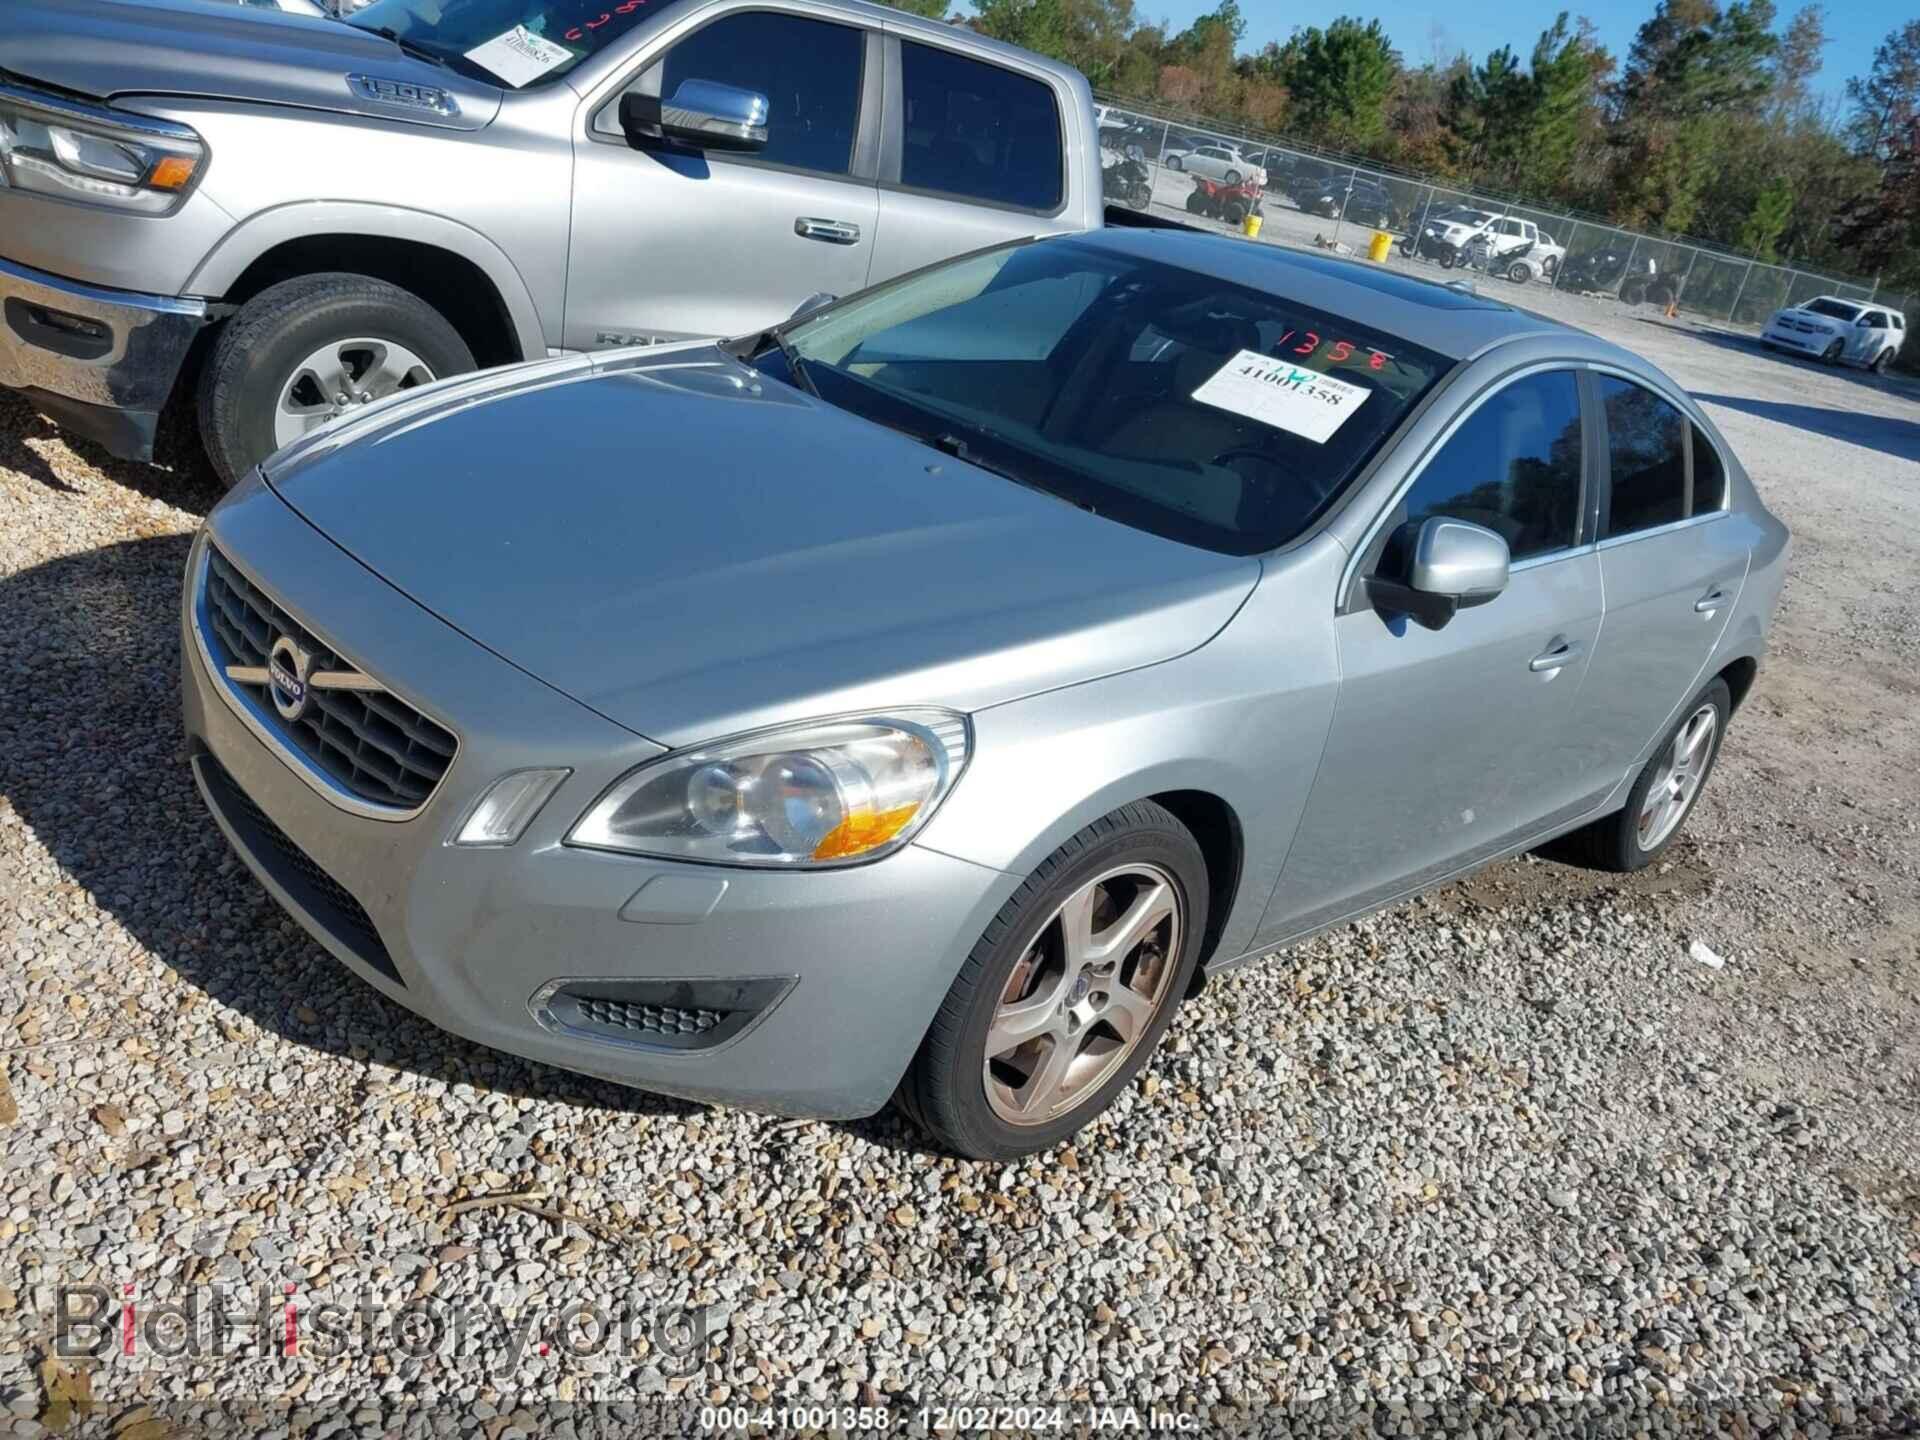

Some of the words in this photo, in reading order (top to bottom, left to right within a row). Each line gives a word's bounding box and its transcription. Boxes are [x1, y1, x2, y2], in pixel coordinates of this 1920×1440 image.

[1278, 330, 1386, 370] 1358
[1239, 365, 1343, 406] 41001358
[271, 663, 301, 696] VOLVO
